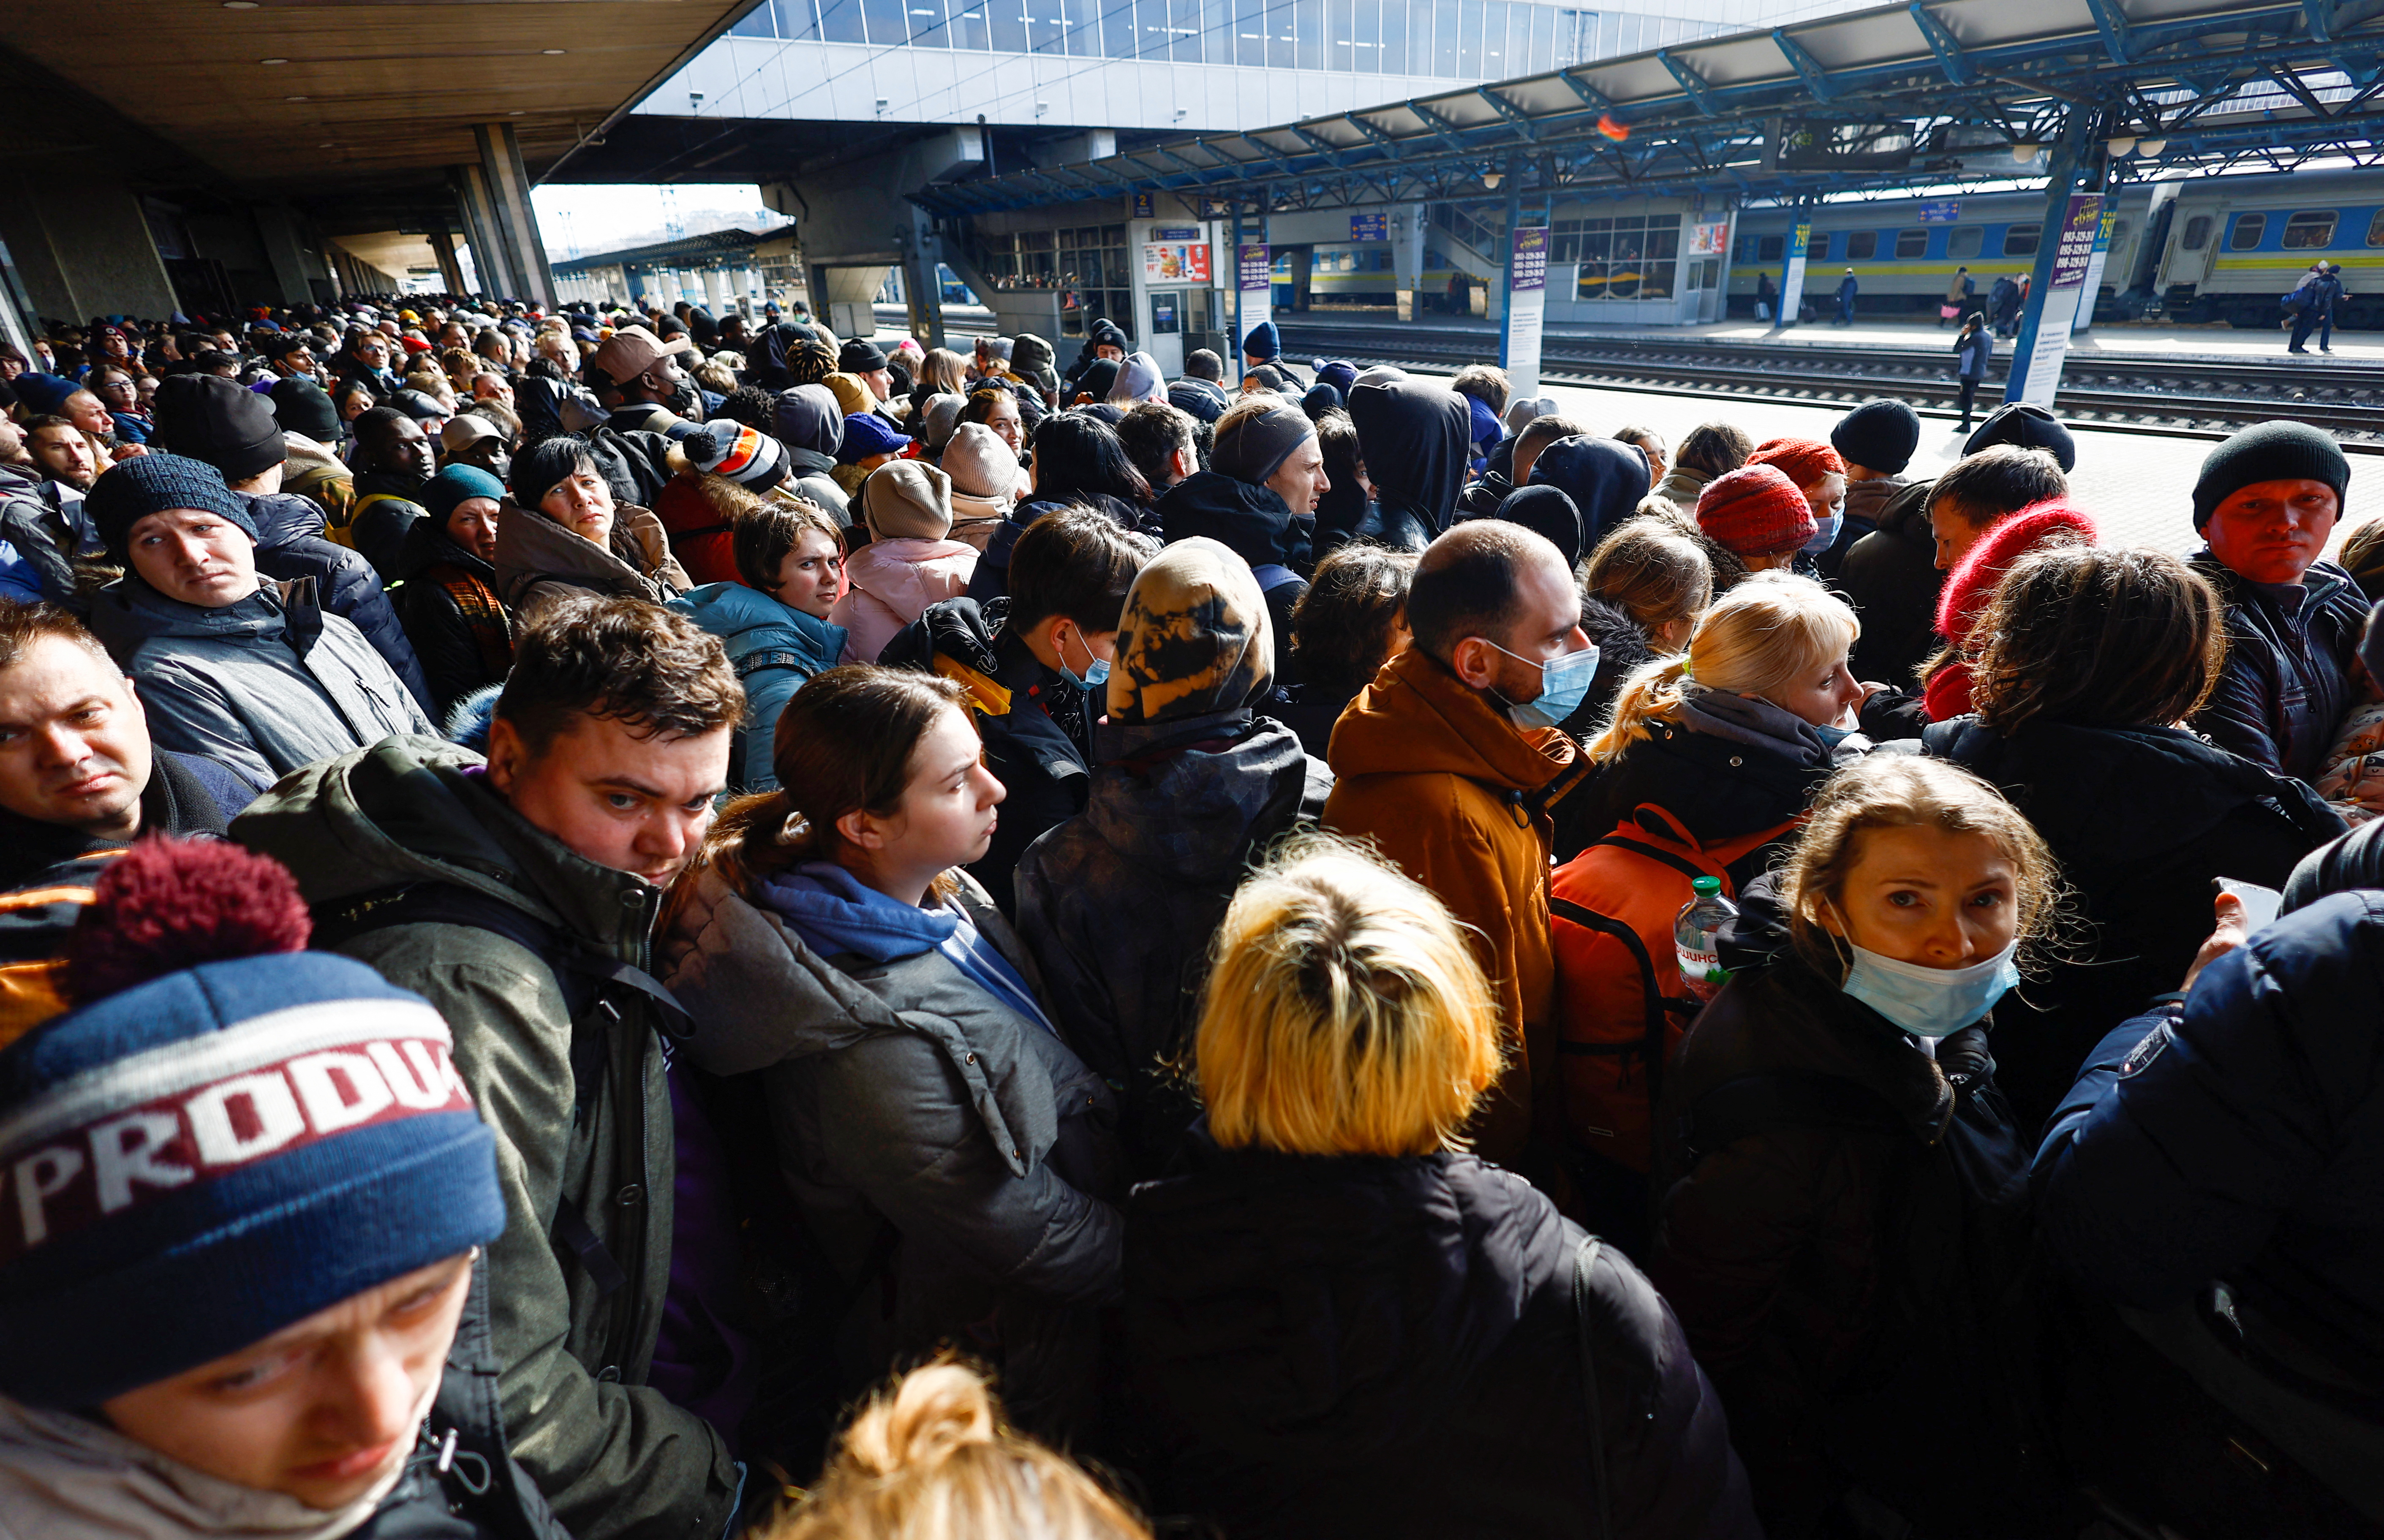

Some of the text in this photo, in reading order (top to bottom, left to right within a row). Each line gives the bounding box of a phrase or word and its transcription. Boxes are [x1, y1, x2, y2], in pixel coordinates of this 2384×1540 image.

[1778, 136, 1788, 159] 2
[1139, 195, 1147, 206] 2
[14, 1039, 472, 1245] PRODU
